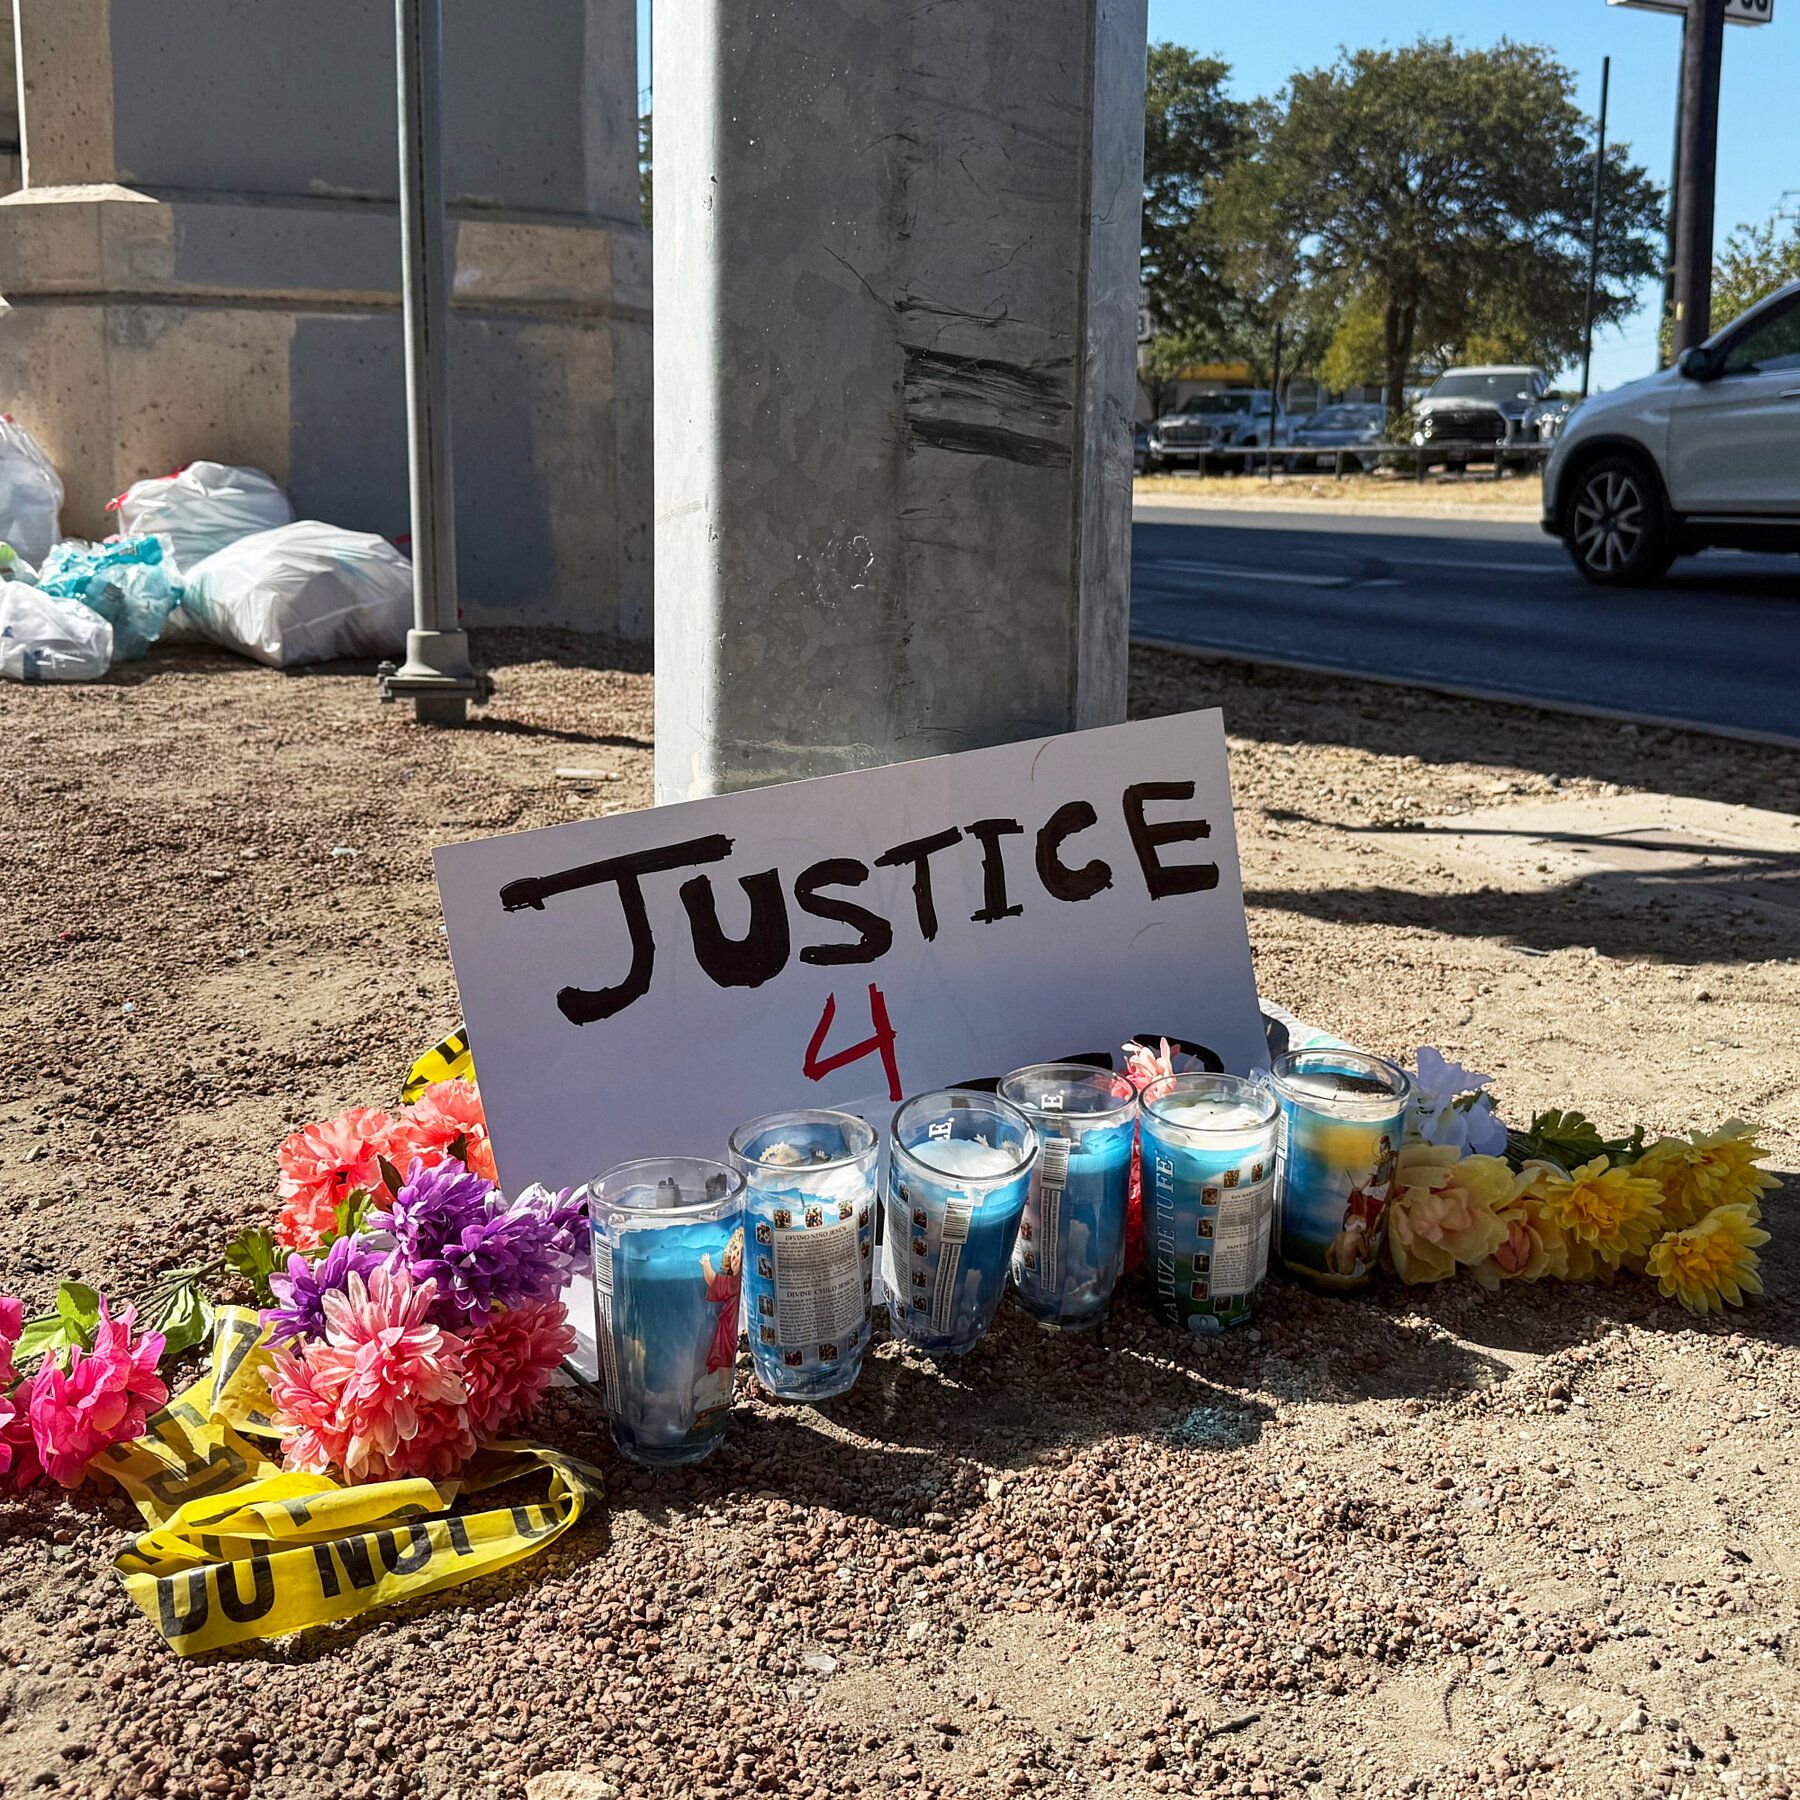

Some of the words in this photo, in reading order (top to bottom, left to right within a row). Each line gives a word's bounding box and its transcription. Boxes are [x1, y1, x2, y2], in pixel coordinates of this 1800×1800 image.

[499, 780, 1219, 1025] JUSTICE
[801, 982, 904, 1102] 4
[1156, 1193, 1174, 1222] TU
[785, 1232, 809, 1241] DIVINO
[1157, 1226, 1176, 1255] DE
[786, 1289, 811, 1298] DIVINE
[814, 1284, 837, 1295] CHILD
[1157, 1257, 1176, 1298] LUZ
